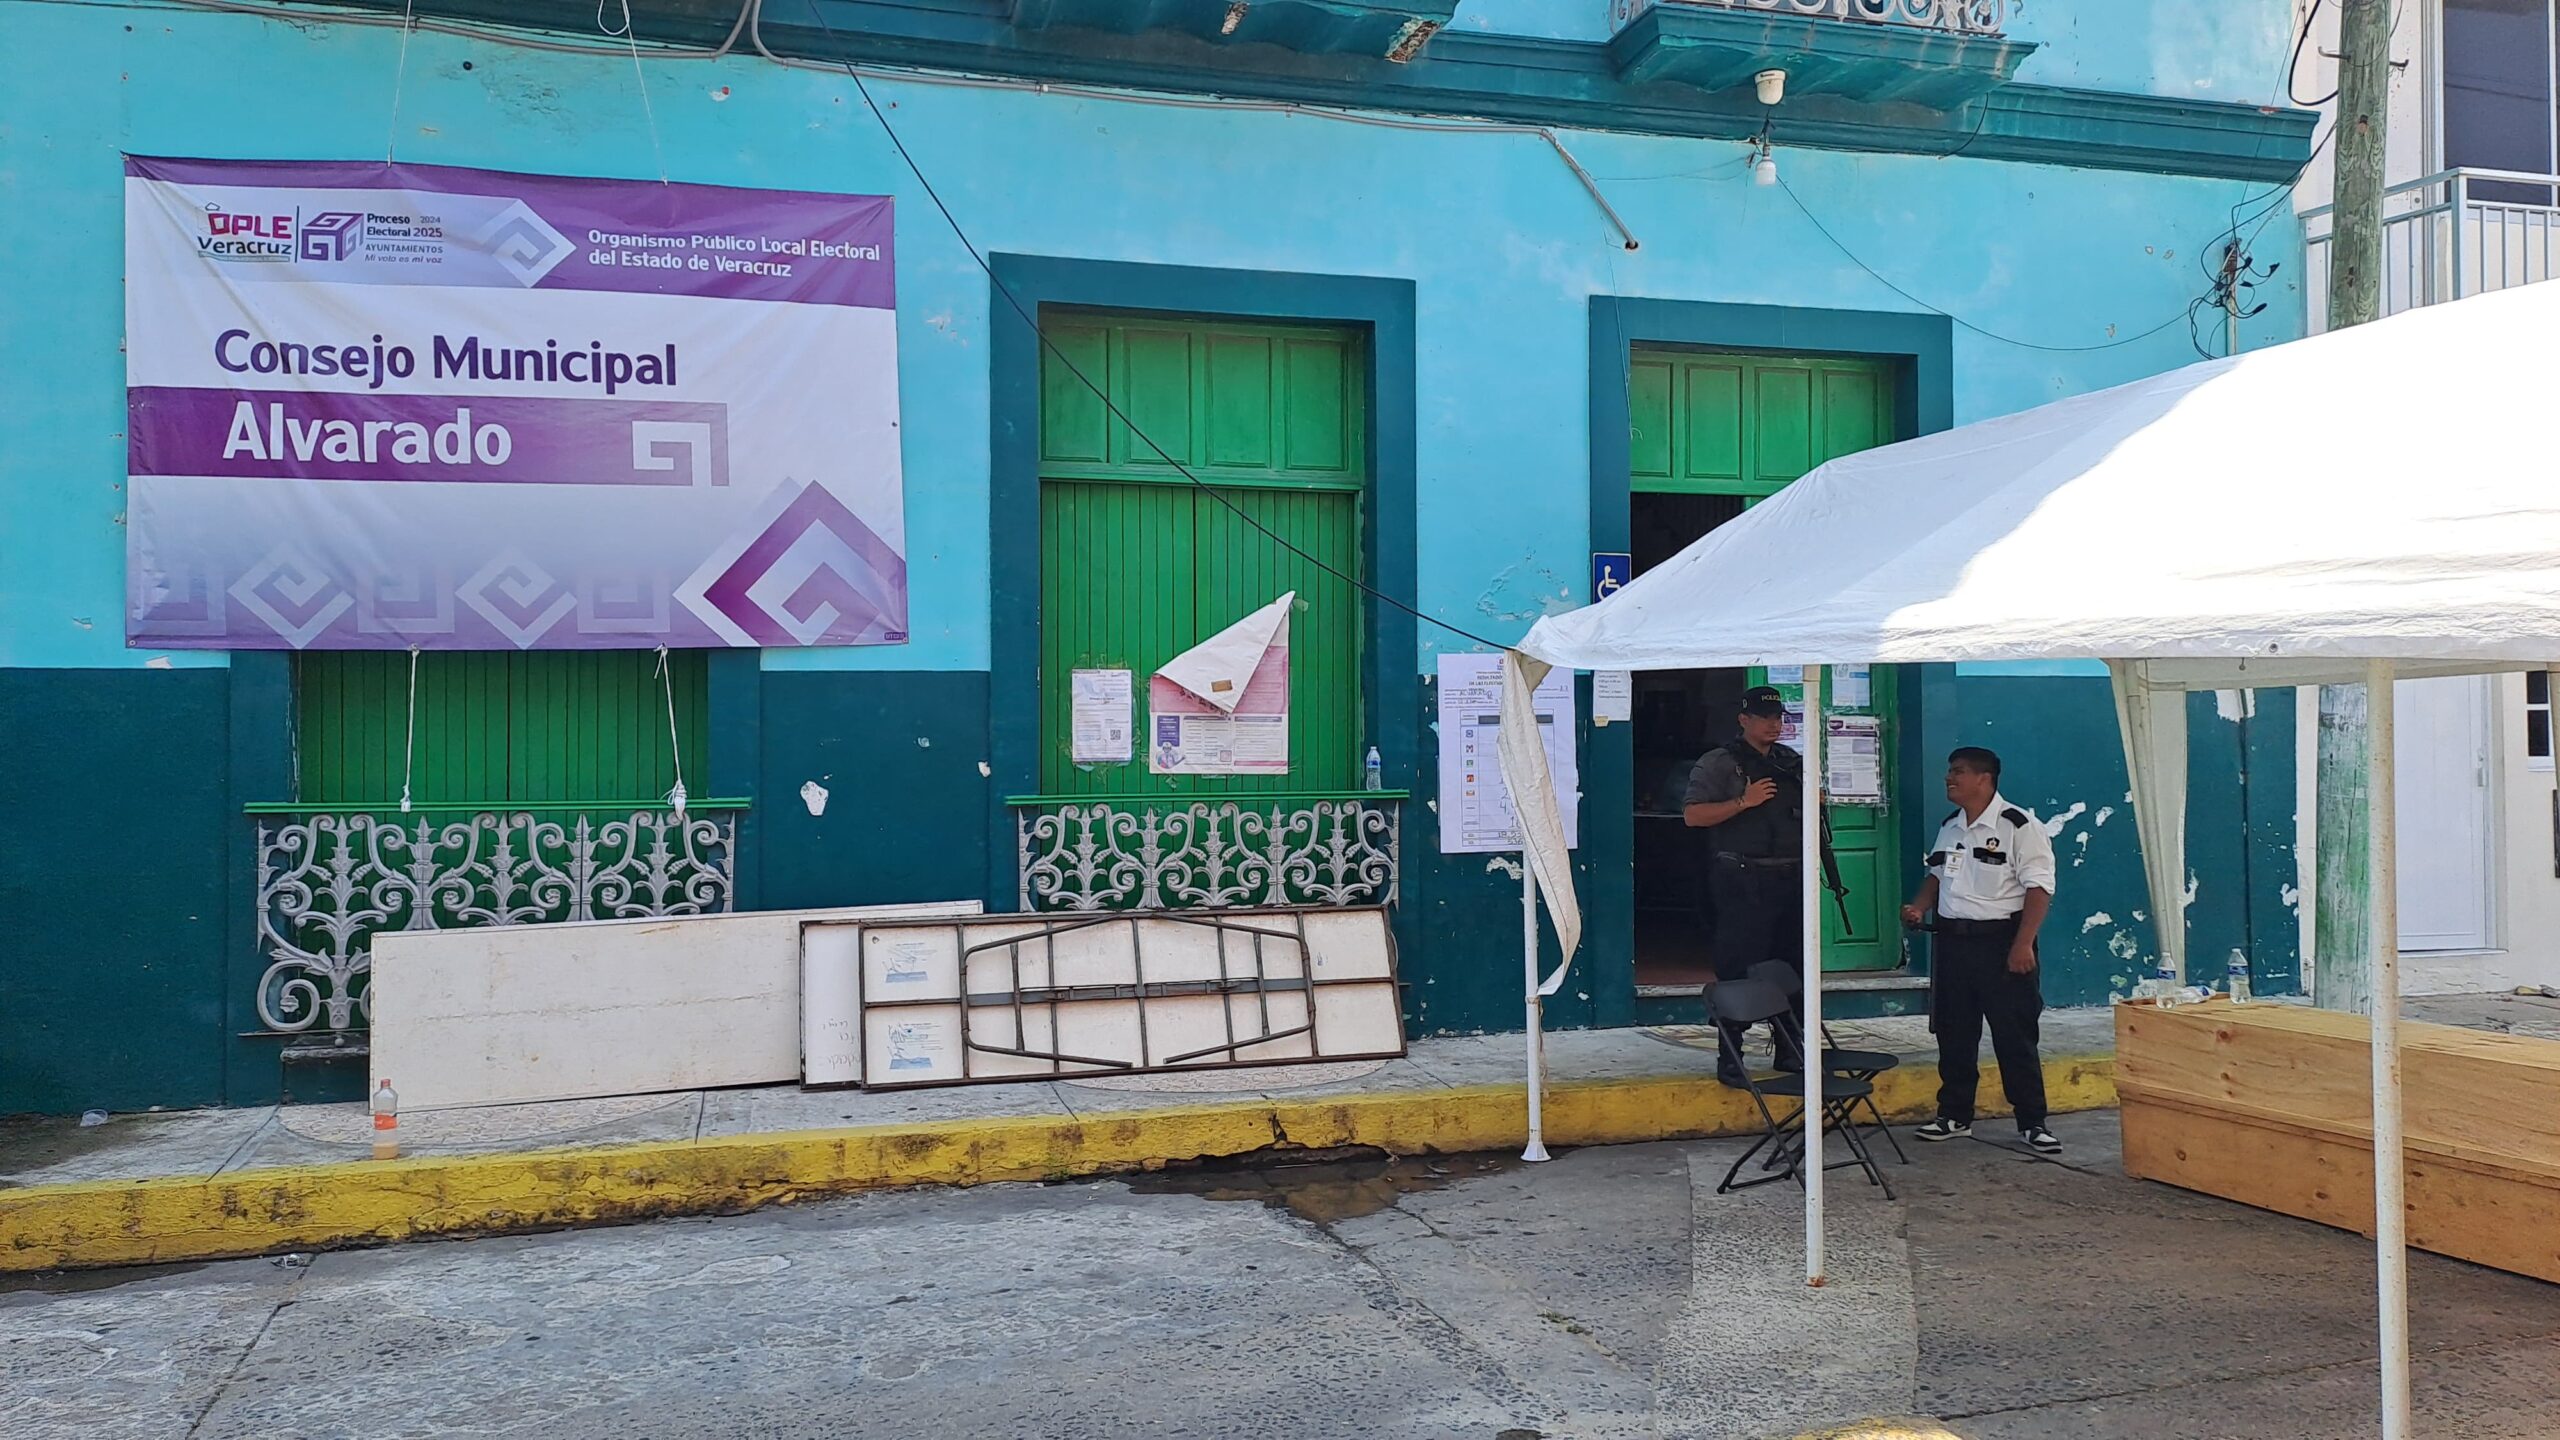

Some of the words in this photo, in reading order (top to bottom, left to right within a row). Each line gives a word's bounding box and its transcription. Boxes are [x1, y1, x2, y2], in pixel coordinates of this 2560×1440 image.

[207, 212, 292, 239] OPLE
[367, 213, 411, 225] Proceso
[419, 215, 441, 224] 2024
[367, 226, 411, 237] Electoral
[413, 227, 443, 238] 2025
[197, 236, 292, 255] Veracruz
[365, 243, 443, 254] AYUNTAMIENTOS
[588, 229, 686, 250] Organismo
[691, 234, 756, 253] Público
[761, 237, 806, 257] Local
[810, 240, 880, 261] Electoral
[589, 249, 616, 266] del
[621, 251, 682, 270] Estado
[688, 254, 709, 272] de
[715, 256, 792, 277] Veracruz
[214, 328, 415, 389] Consejo
[432, 335, 677, 395] Municipal
[222, 400, 513, 466] Alvarado
